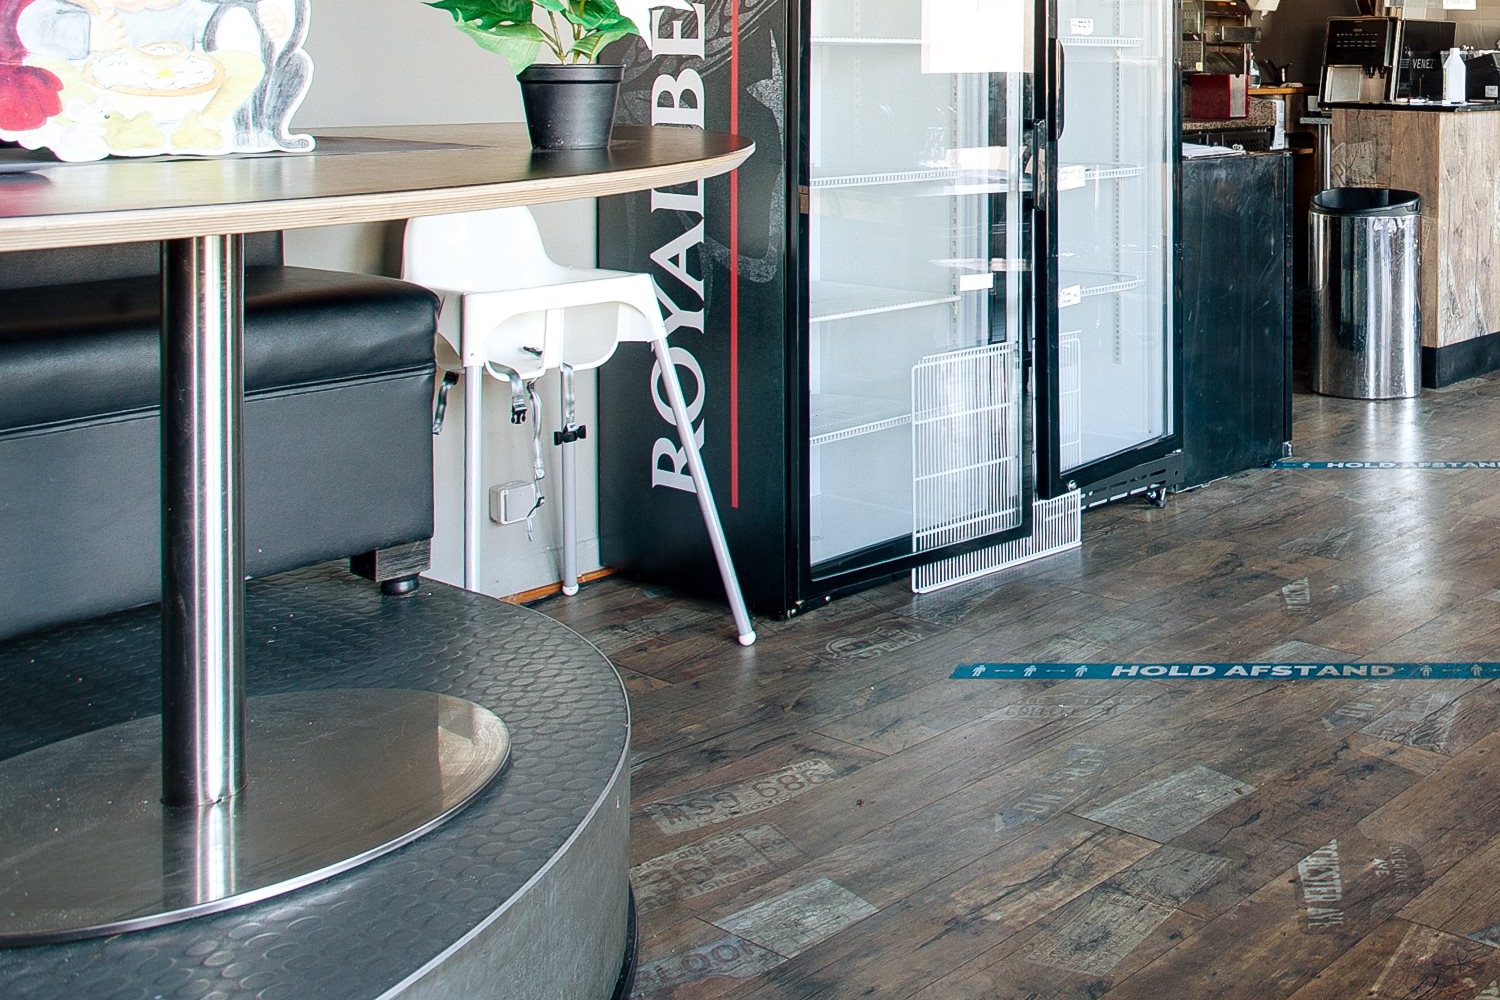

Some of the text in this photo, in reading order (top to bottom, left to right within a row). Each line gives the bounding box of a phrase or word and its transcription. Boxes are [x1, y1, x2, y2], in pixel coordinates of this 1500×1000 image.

[1327, 461, 1396, 469] HOLD
[1111, 665, 1396, 677] HOLD AFSTAND
